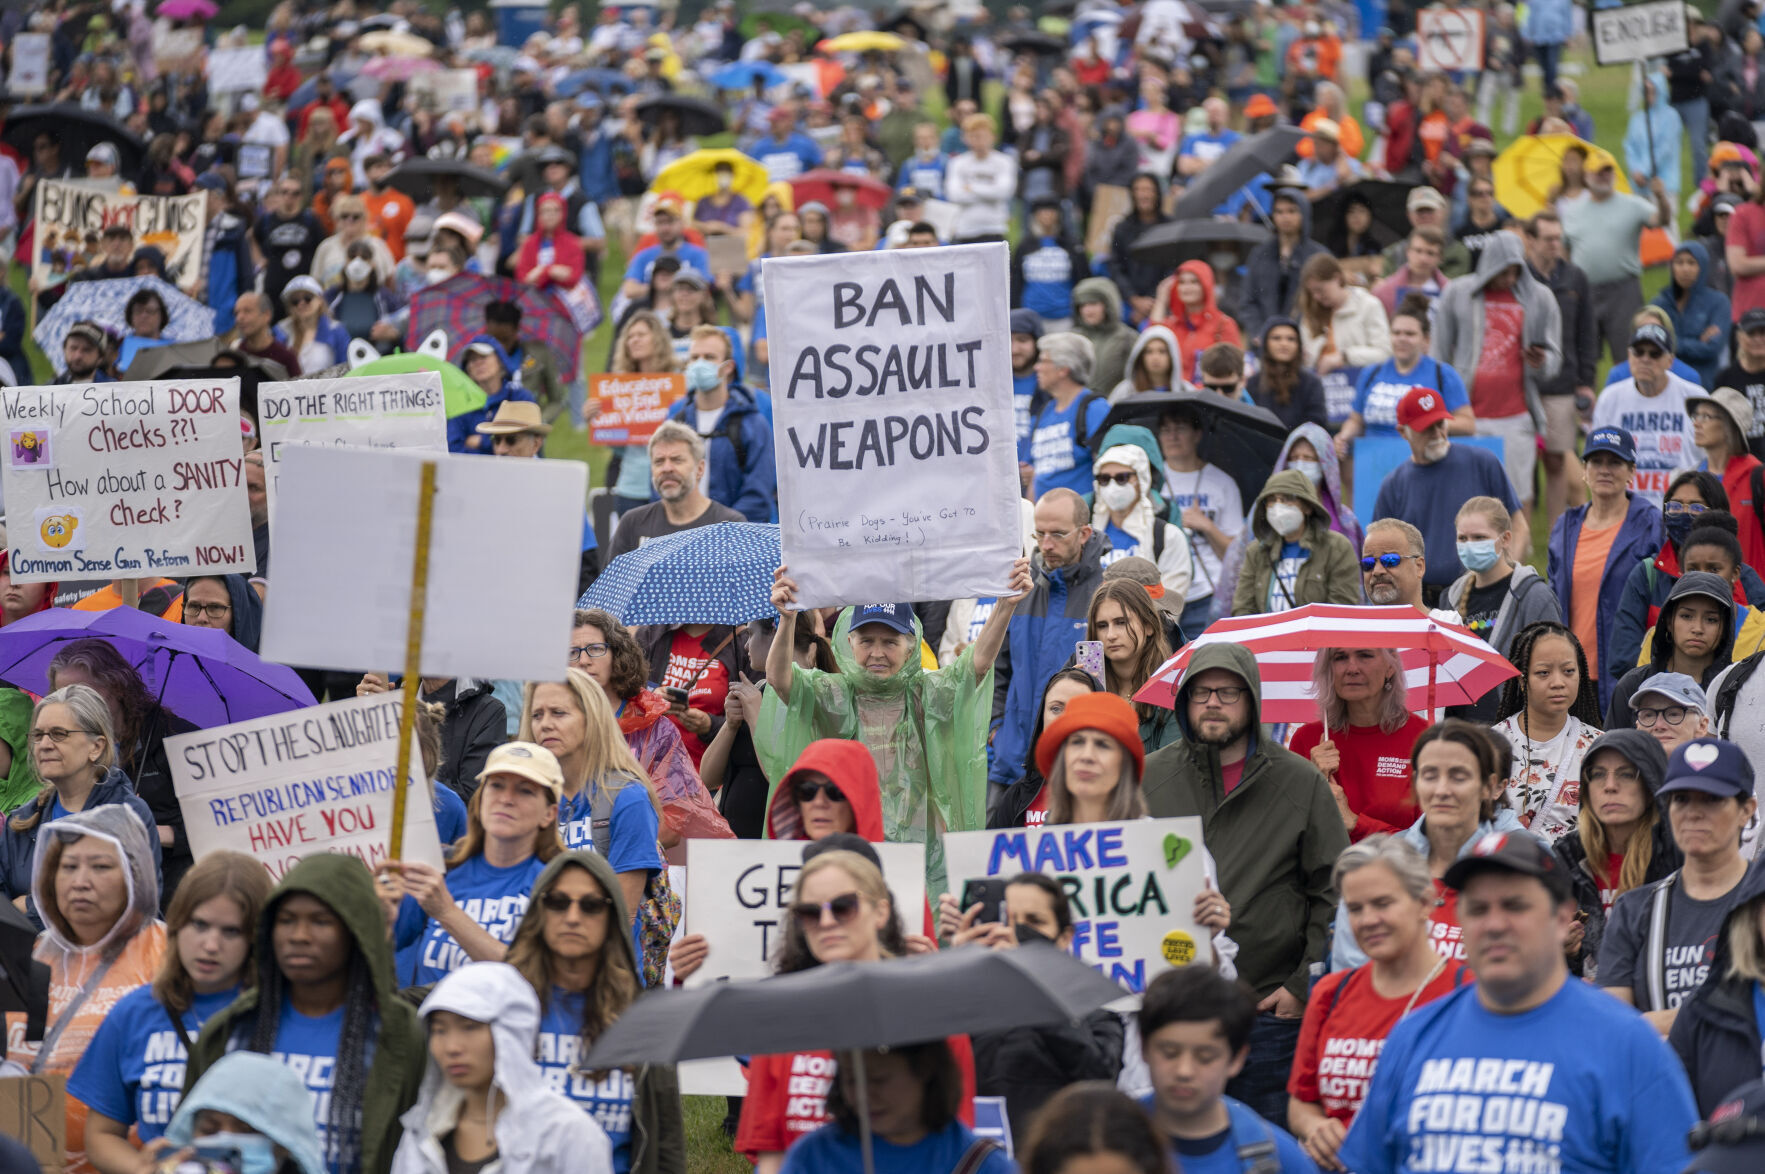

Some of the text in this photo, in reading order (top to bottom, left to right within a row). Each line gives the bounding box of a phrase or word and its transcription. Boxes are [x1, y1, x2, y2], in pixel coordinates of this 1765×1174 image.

[833, 272, 955, 329] BAN
[597, 377, 673, 398] Educators
[787, 340, 982, 399] ASSAULT
[3, 386, 227, 428] Weekly School DOOR
[263, 388, 442, 420] DO THE RIGHT THINGS:
[1621, 411, 1684, 433] MARCH
[787, 406, 990, 470] WEAPONS
[47, 458, 242, 500] How about a SANITY
[902, 511, 932, 527] You've
[940, 508, 957, 519] Got
[12, 545, 245, 574] Common Sense Gun Reform NOW!
[183, 731, 250, 781] STOP
[248, 722, 308, 767] THE
[1376, 767, 1402, 775] ACTION
[1377, 762, 1407, 770] DEMAND
[209, 779, 327, 827] REPUBLICAN
[248, 804, 375, 852] HAVE YOU
[988, 828, 1128, 875] MAKE
[736, 863, 801, 909] GE
[1666, 965, 1711, 990] ENS
[1414, 1057, 1555, 1098] MARCH
[1407, 1094, 1569, 1142] FOR OUR
[1407, 1133, 1506, 1174] LIVES
